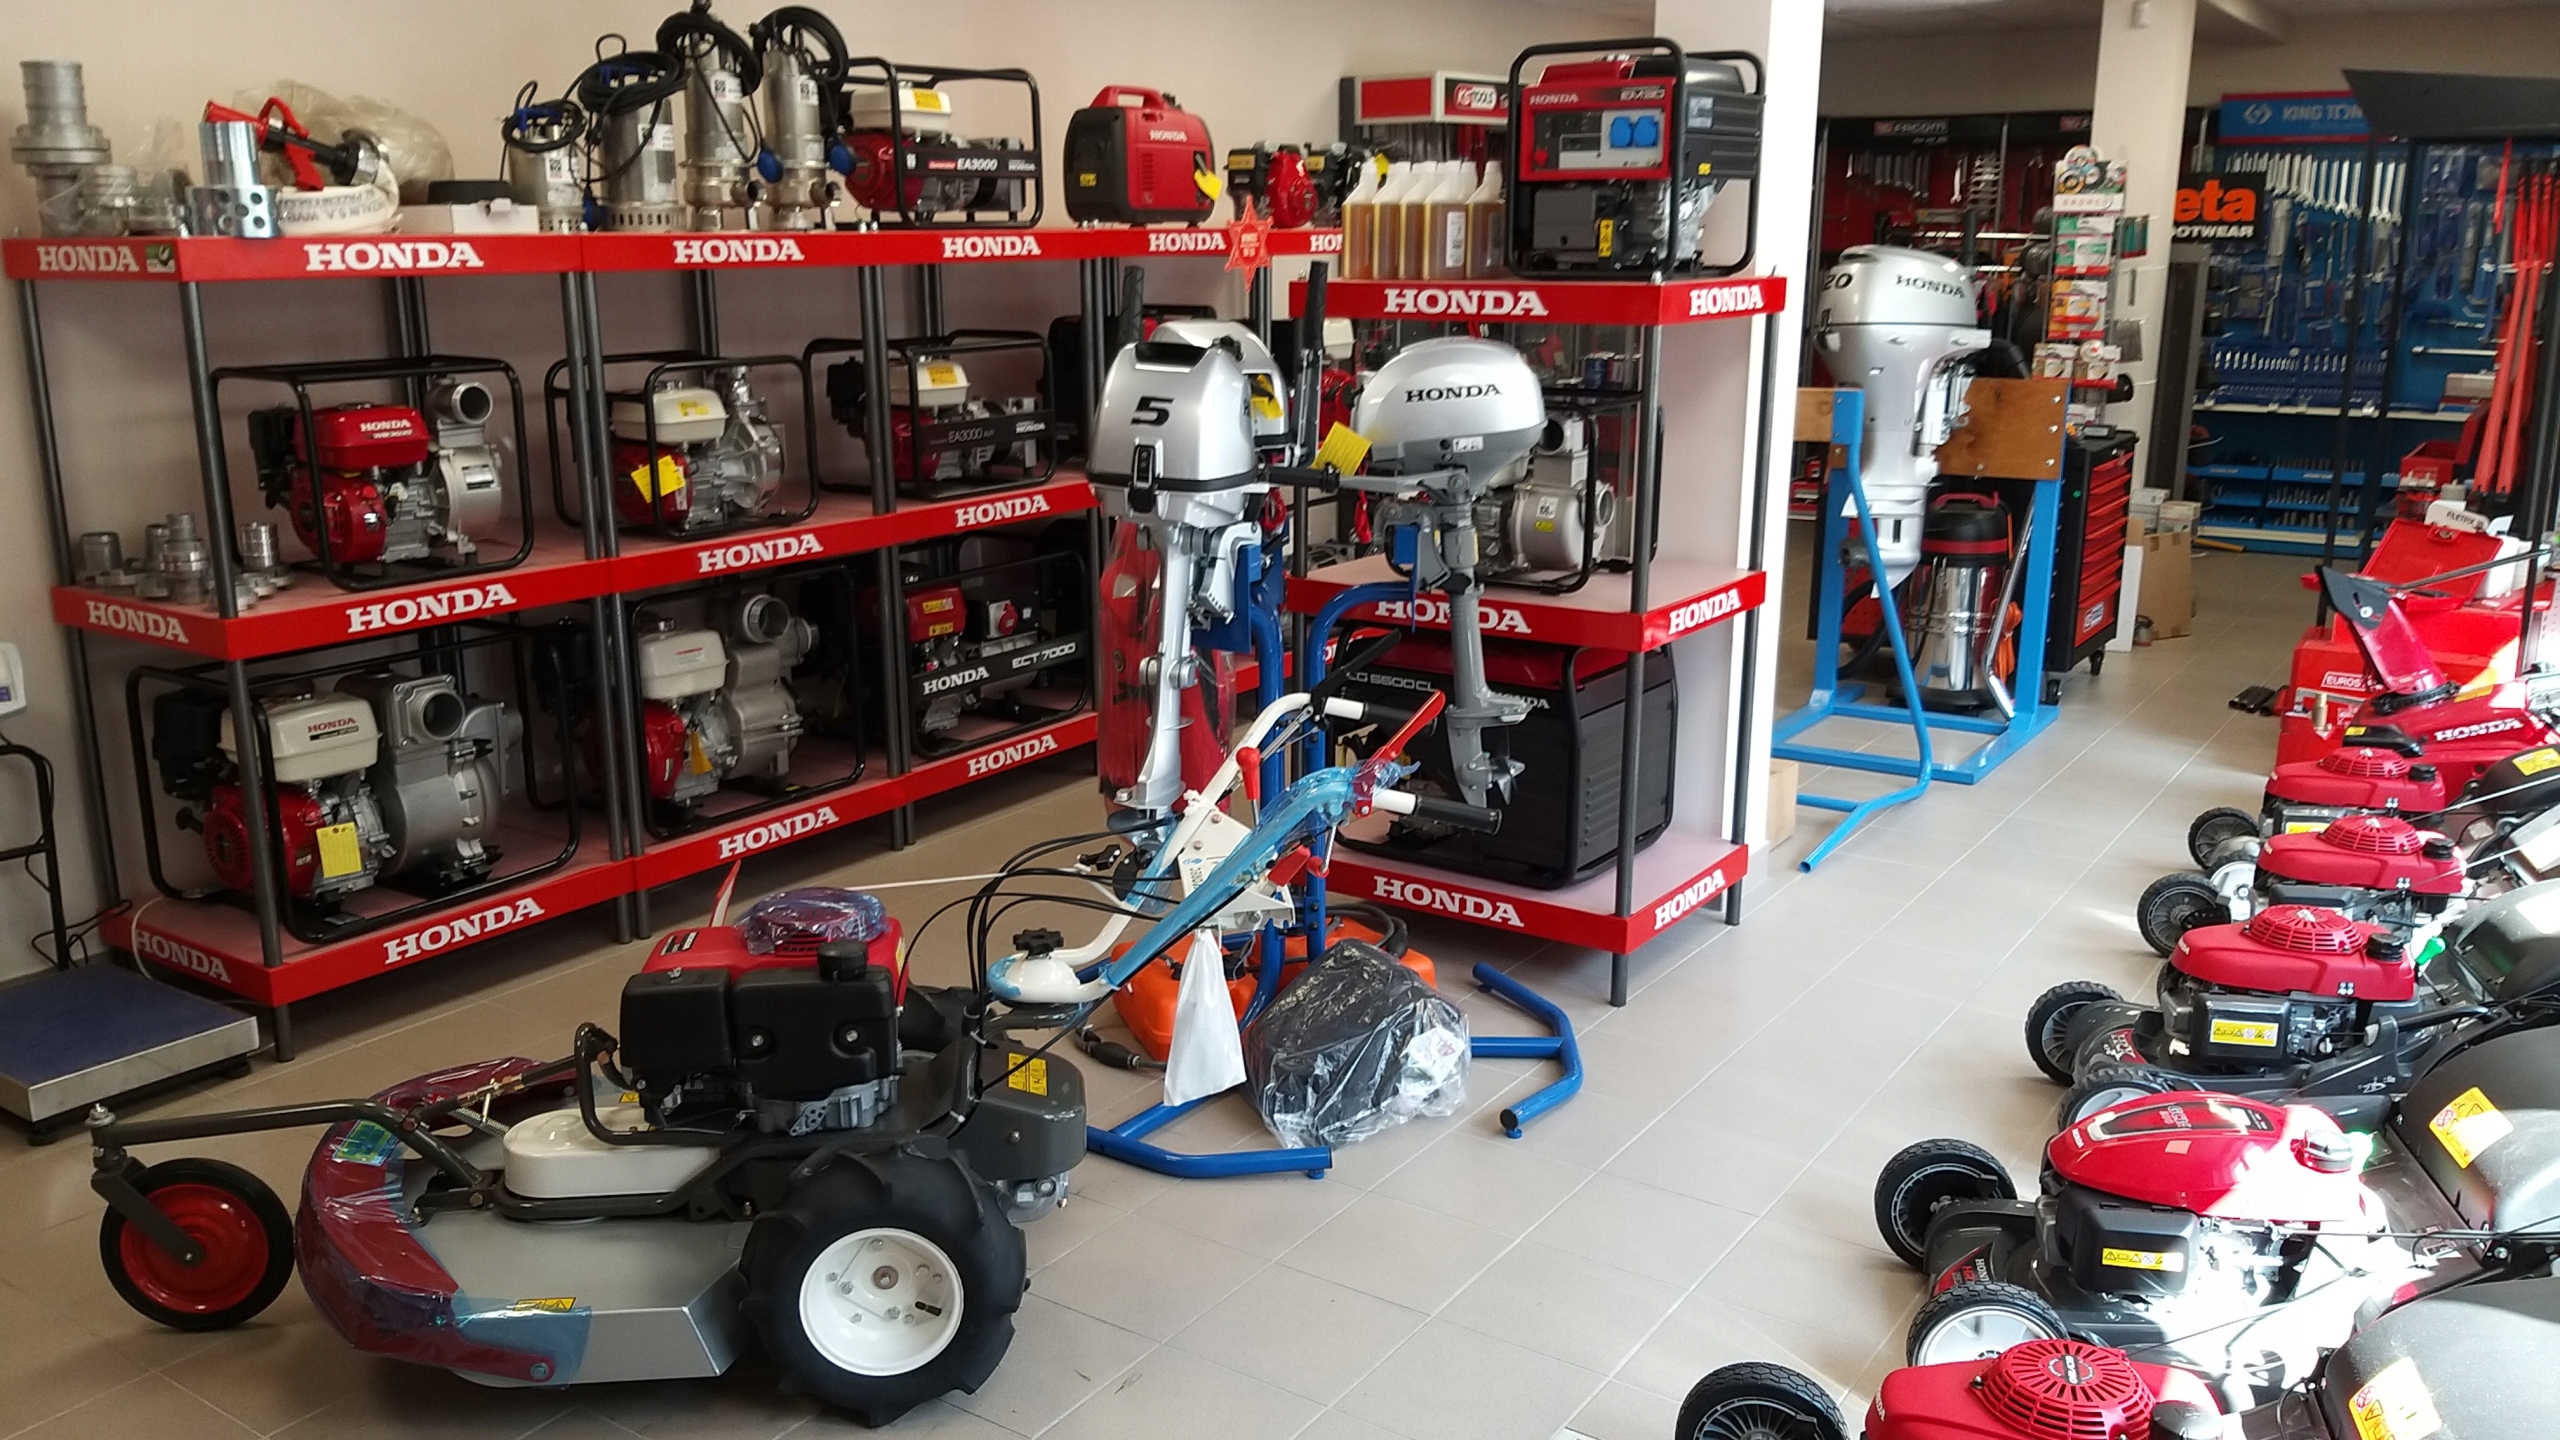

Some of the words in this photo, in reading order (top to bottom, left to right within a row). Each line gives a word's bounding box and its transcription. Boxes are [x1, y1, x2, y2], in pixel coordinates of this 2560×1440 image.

[1529, 93, 1580, 106] HONDA
[1150, 129, 1187, 142] HONDA
[957, 158, 998, 172] EA3000
[2174, 179, 2257, 222] eta
[1149, 232, 1226, 252] HONDA
[2171, 225, 2254, 238] OTWEAR
[38, 246, 140, 273] HONDA
[305, 242, 484, 270] HONDA
[673, 240, 805, 263] HONDA
[942, 236, 1042, 258] HONDA
[1824, 273, 1853, 291] 20
[1896, 274, 1966, 299] HONDA
[1384, 289, 1548, 317] HONDA
[1689, 286, 1764, 315] HONDA
[1405, 384, 1503, 403] HONDA
[1130, 396, 1174, 426] 5
[360, 419, 411, 432] HONDA
[955, 495, 1050, 528] HONDA
[698, 534, 823, 573] HONDA
[87, 601, 189, 643] HONDA
[346, 584, 517, 633] HONDA
[1668, 588, 1741, 635] HONDA
[923, 667, 990, 695] HONDA
[1012, 652, 1042, 670] ECT
[1042, 642, 1076, 662] 7000
[308, 717, 357, 733] HONDA
[2434, 718, 2524, 742] HONDA
[967, 734, 1058, 777] HONDA
[719, 807, 840, 859] HONDA
[1373, 875, 1524, 928] HONDA
[1653, 869, 1725, 930] HONDA
[384, 896, 545, 965] HONDA
[134, 928, 231, 984] HONDA
